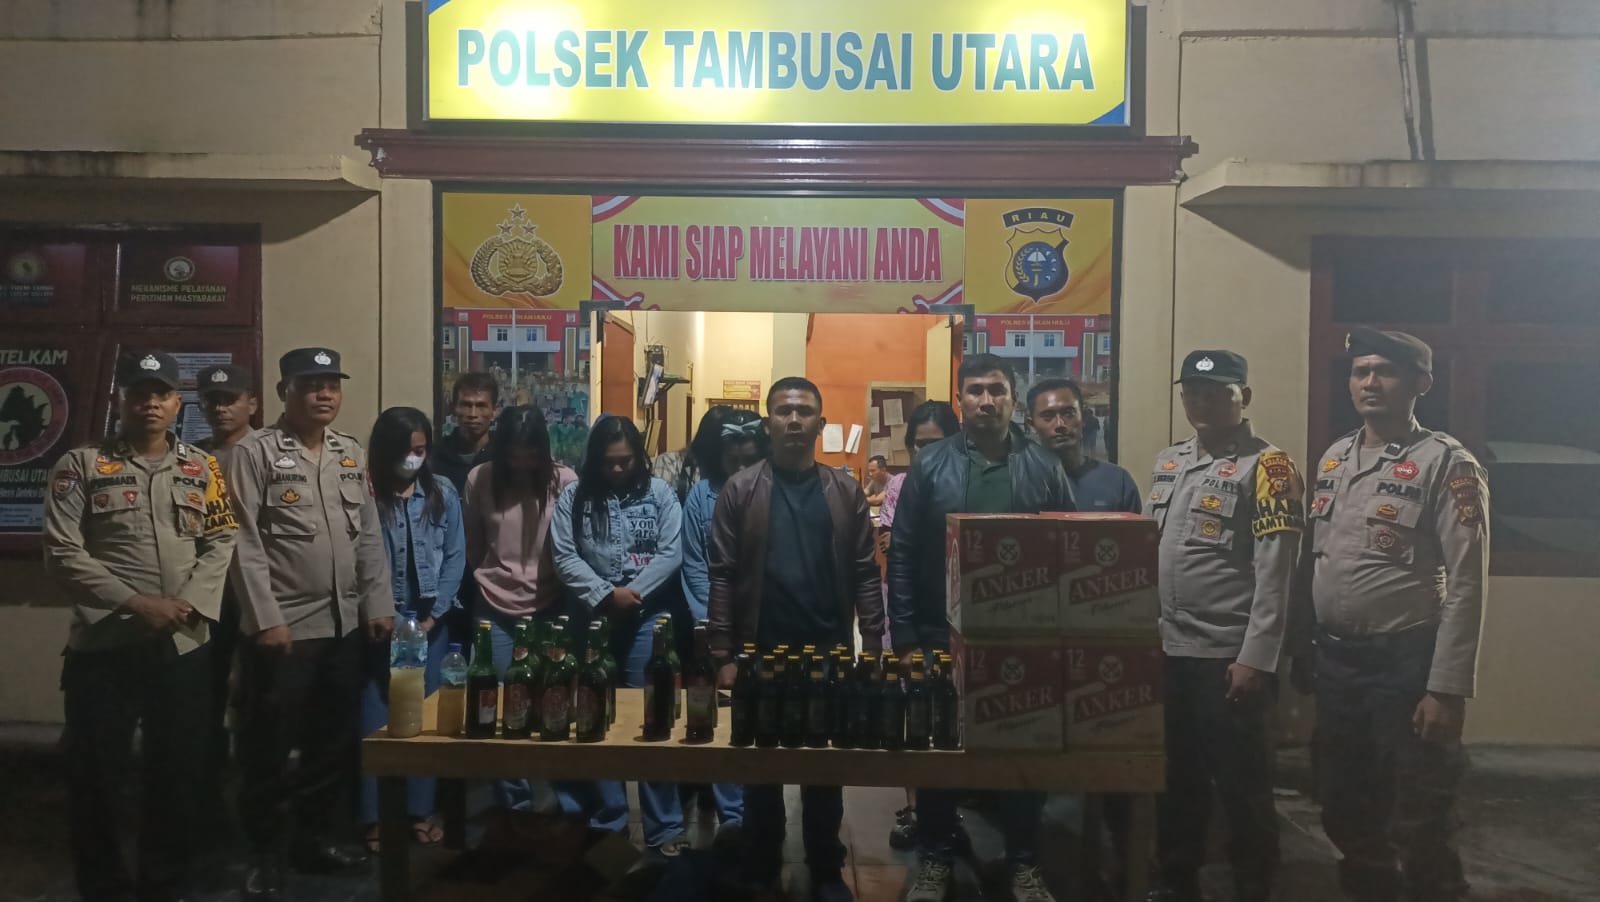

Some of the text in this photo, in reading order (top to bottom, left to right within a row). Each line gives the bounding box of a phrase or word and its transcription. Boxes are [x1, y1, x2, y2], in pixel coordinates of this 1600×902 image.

[457, 28, 1095, 91] POLSEK TAMBUSAI UTARA
[1011, 212, 1065, 223] RIAU
[613, 223, 943, 281] KAMI SIAP MELAYANI ANDA
[130, 294, 226, 303] PERIZINAN MASYARAKAT
[131, 284, 227, 293] MEKANISME PELAYANAN
[630, 518, 654, 532] you
[635, 529, 655, 539] are
[964, 529, 983, 549] 12
[1061, 531, 1081, 550] 12
[972, 566, 1050, 601] ANKER
[1070, 566, 1150, 601] ANKER
[969, 649, 986, 668] 12
[1066, 648, 1086, 668] 12
[977, 686, 1054, 721] ANKER
[1074, 684, 1154, 721] ANKER
